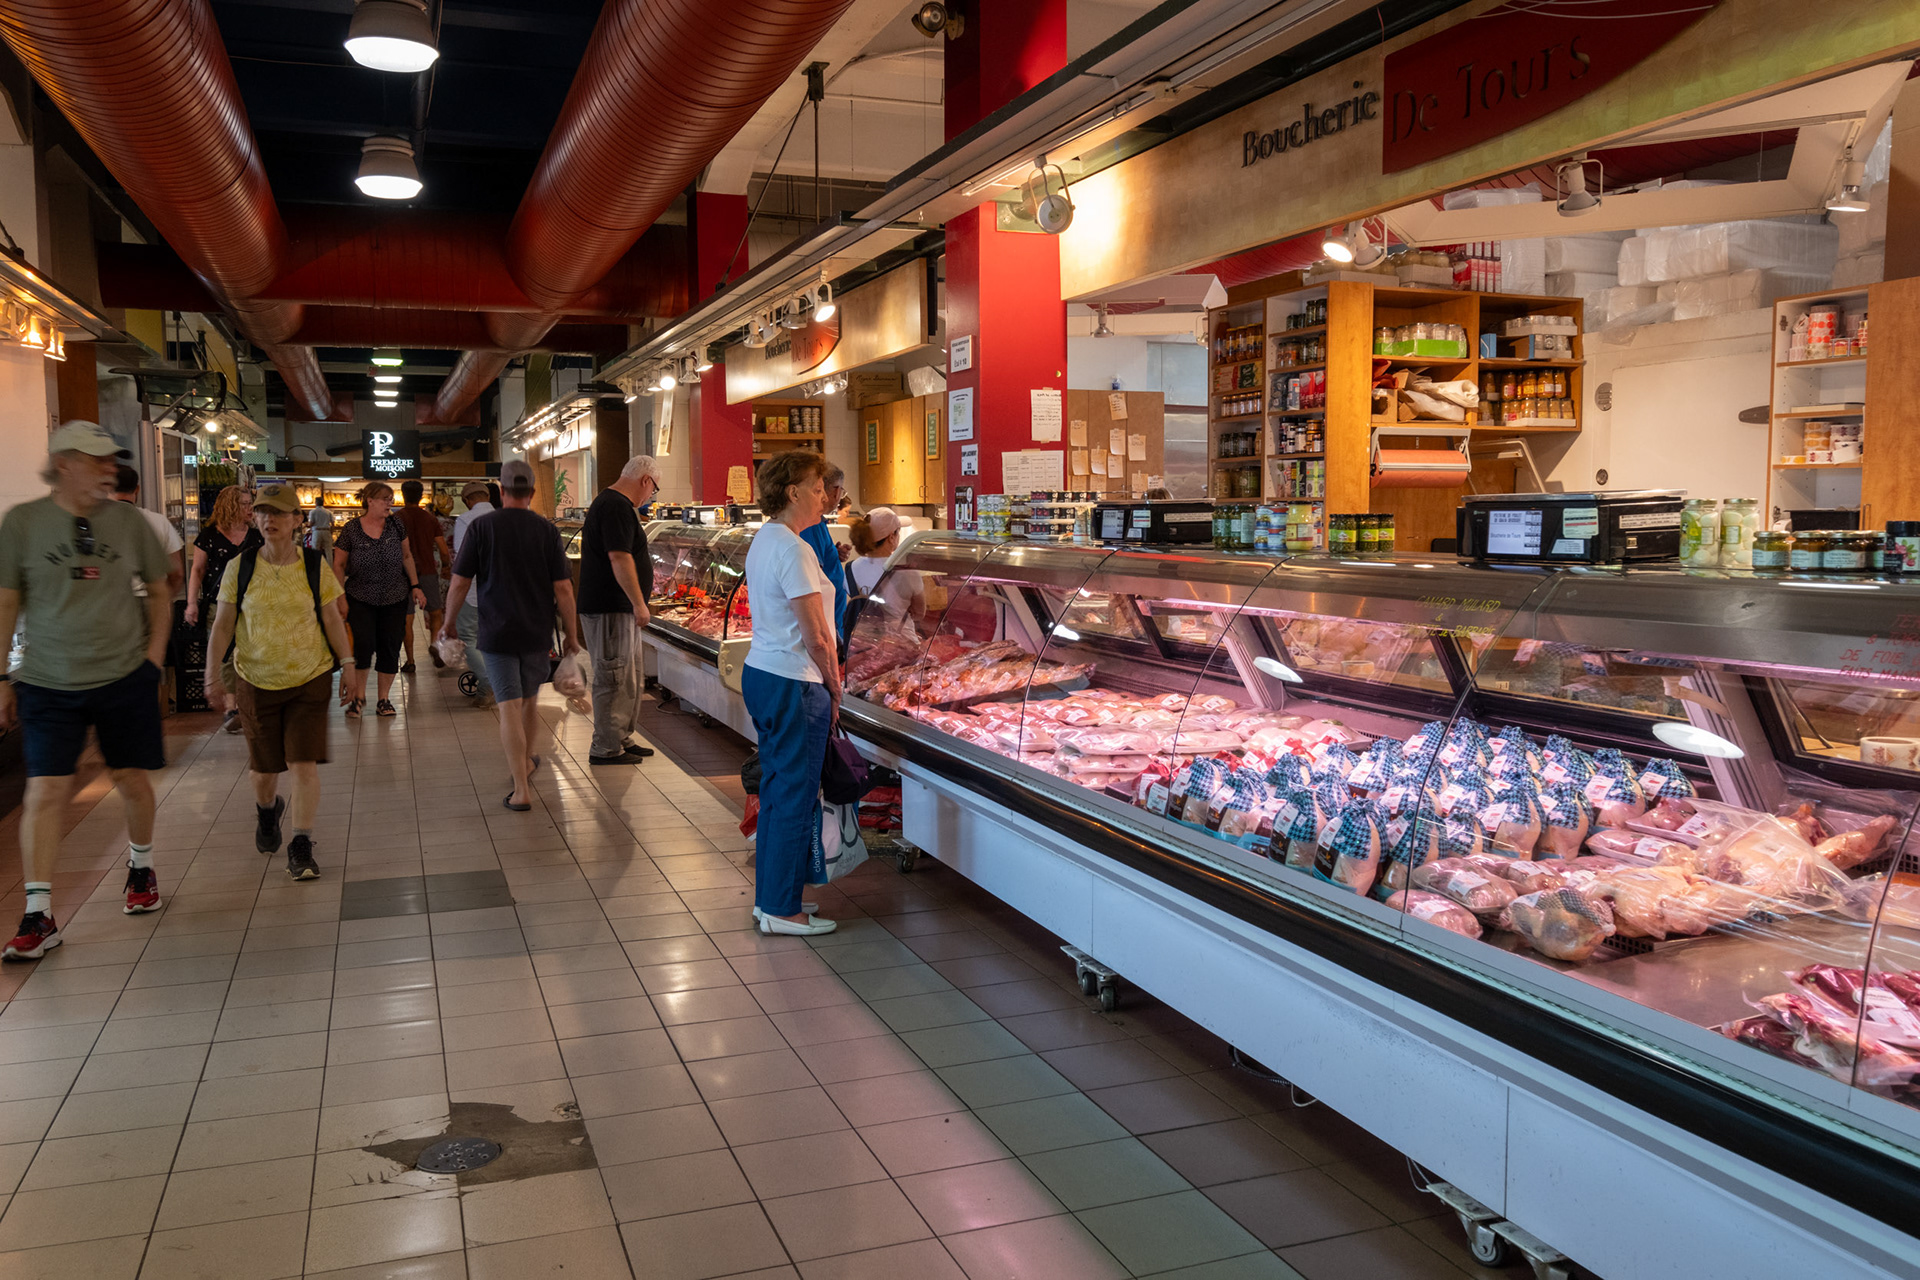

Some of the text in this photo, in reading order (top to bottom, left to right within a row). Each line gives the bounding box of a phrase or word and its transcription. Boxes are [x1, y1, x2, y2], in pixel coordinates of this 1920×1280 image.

[1241, 35, 1591, 168] Boucherie De Tours
[369, 458, 414, 468] PREMIÈRE
[375, 465, 406, 478] MOISON
[1416, 595, 1501, 613] CANARD MULARD
[1840, 648, 1863, 661] DE
[1871, 650, 1904, 665] FOIE
[1839, 665, 1873, 678] FAITS
